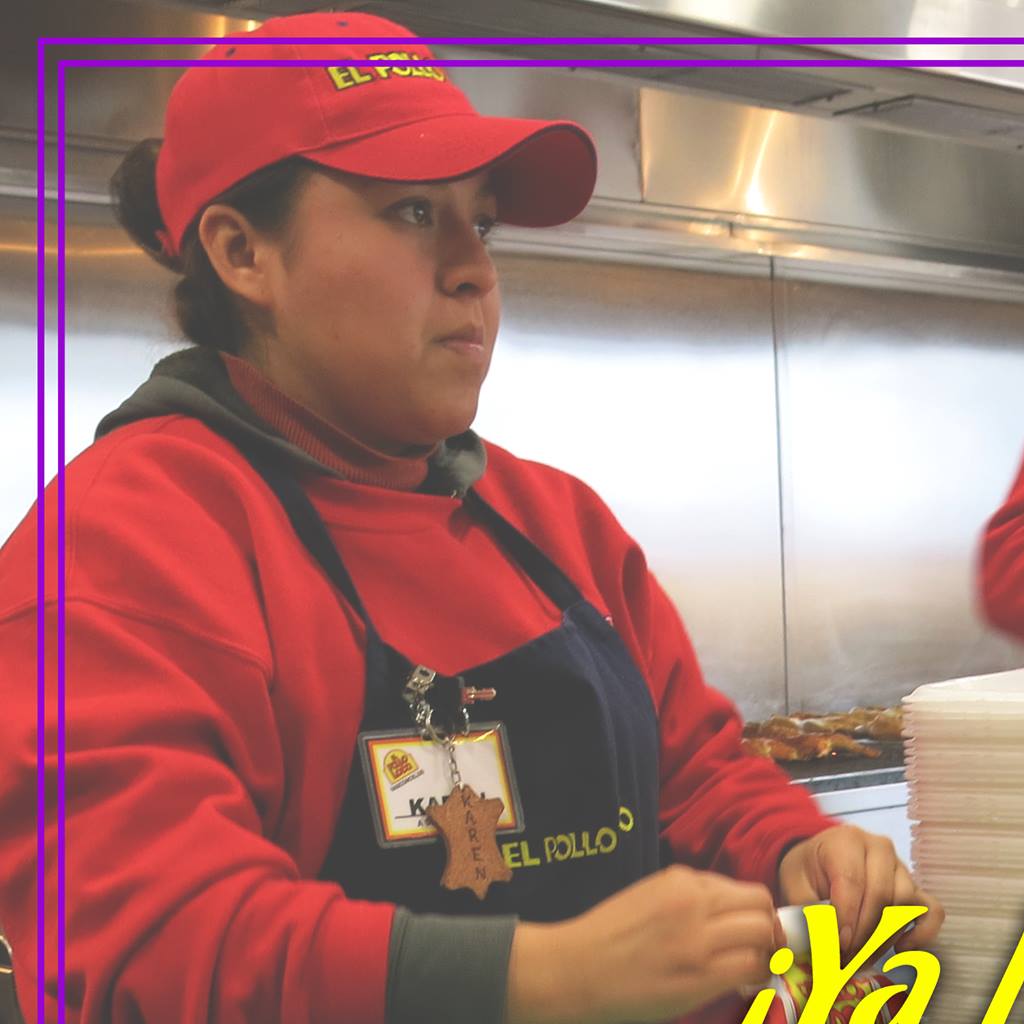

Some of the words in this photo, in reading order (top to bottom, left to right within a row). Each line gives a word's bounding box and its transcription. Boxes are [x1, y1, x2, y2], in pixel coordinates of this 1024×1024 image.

[326, 58, 372, 90] EL
[461, 793, 488, 880] KAREN
[502, 840, 541, 868] EL
[543, 826, 618, 863] POLLO
